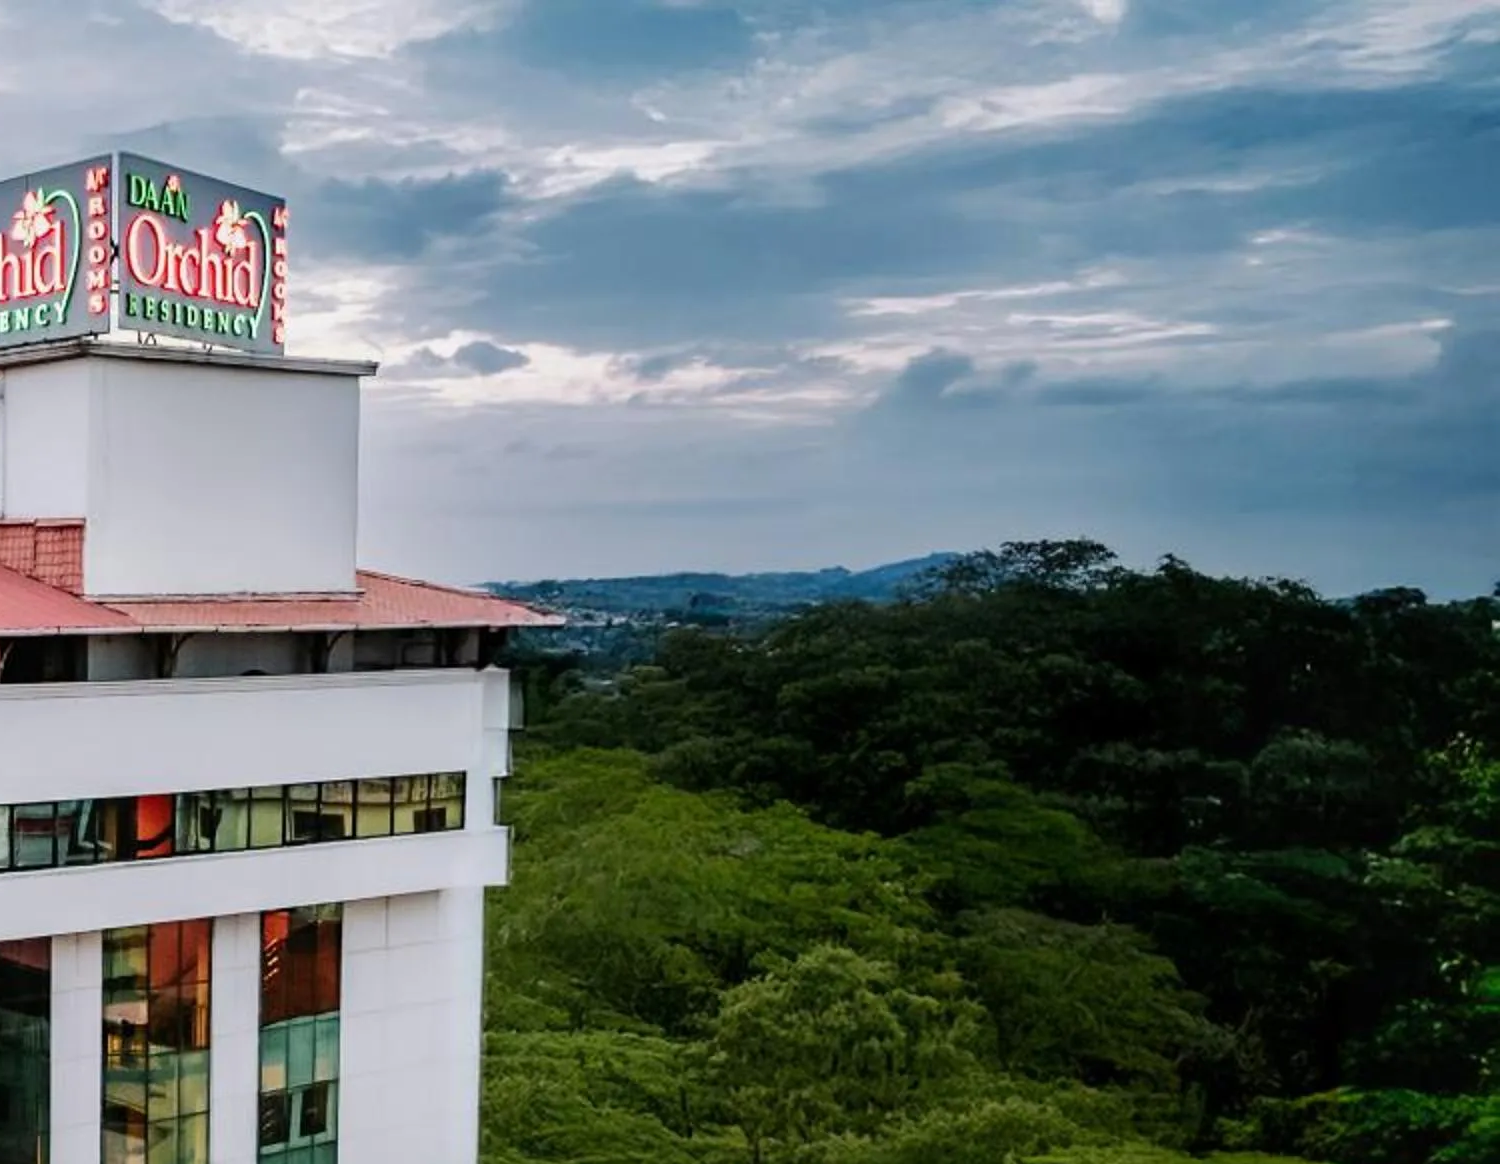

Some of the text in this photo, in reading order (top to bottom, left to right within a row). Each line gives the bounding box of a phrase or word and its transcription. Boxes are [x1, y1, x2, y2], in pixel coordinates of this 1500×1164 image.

[87, 197, 109, 314] ROOMS
[126, 213, 258, 309] Orchid
[126, 293, 260, 340] RESIDENCY
